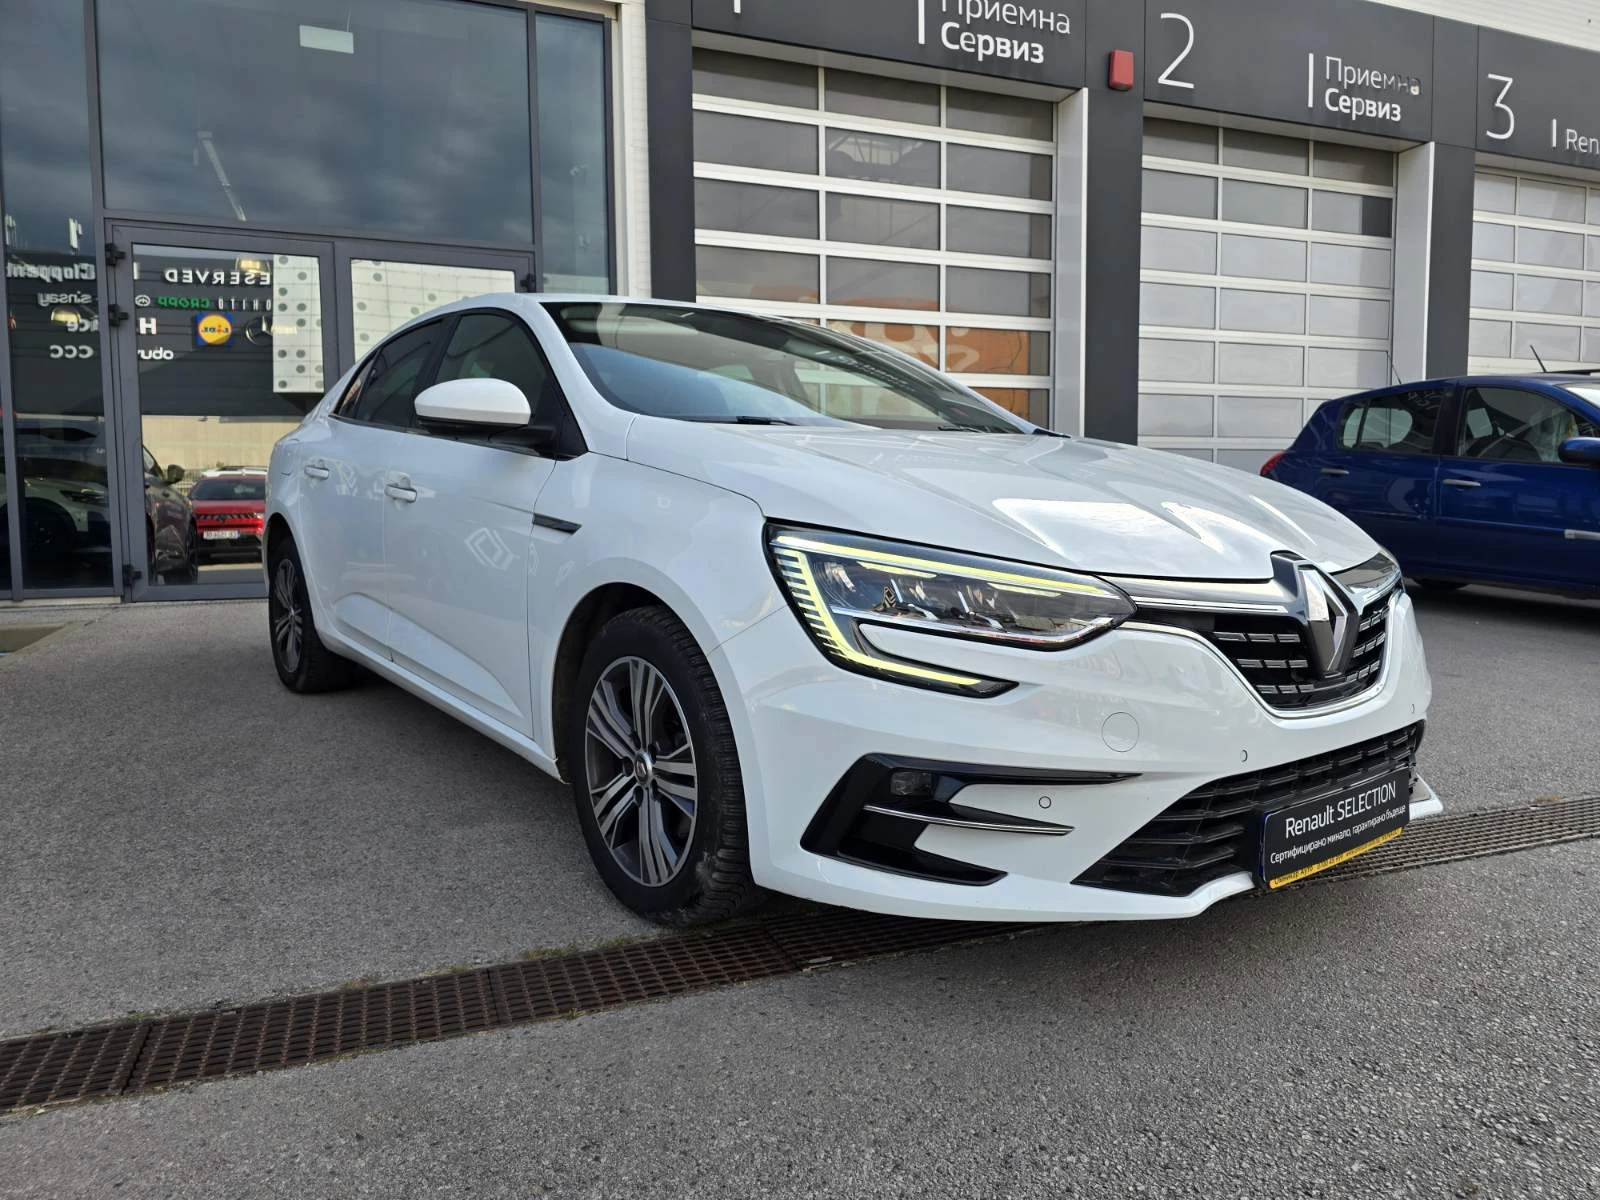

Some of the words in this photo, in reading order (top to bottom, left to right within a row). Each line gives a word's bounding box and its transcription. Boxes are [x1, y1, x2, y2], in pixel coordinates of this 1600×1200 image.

[941, 21, 1044, 63] Сервиз
[1157, 13, 1195, 89] 2
[1325, 87, 1401, 122] Сервиз
[1486, 73, 1515, 140] 3
[1566, 128, 1600, 155] Ren
[1285, 804, 1335, 839] Renault
[1337, 780, 1396, 821] SELECTION
[1270, 838, 1327, 864] Сертифицирано
